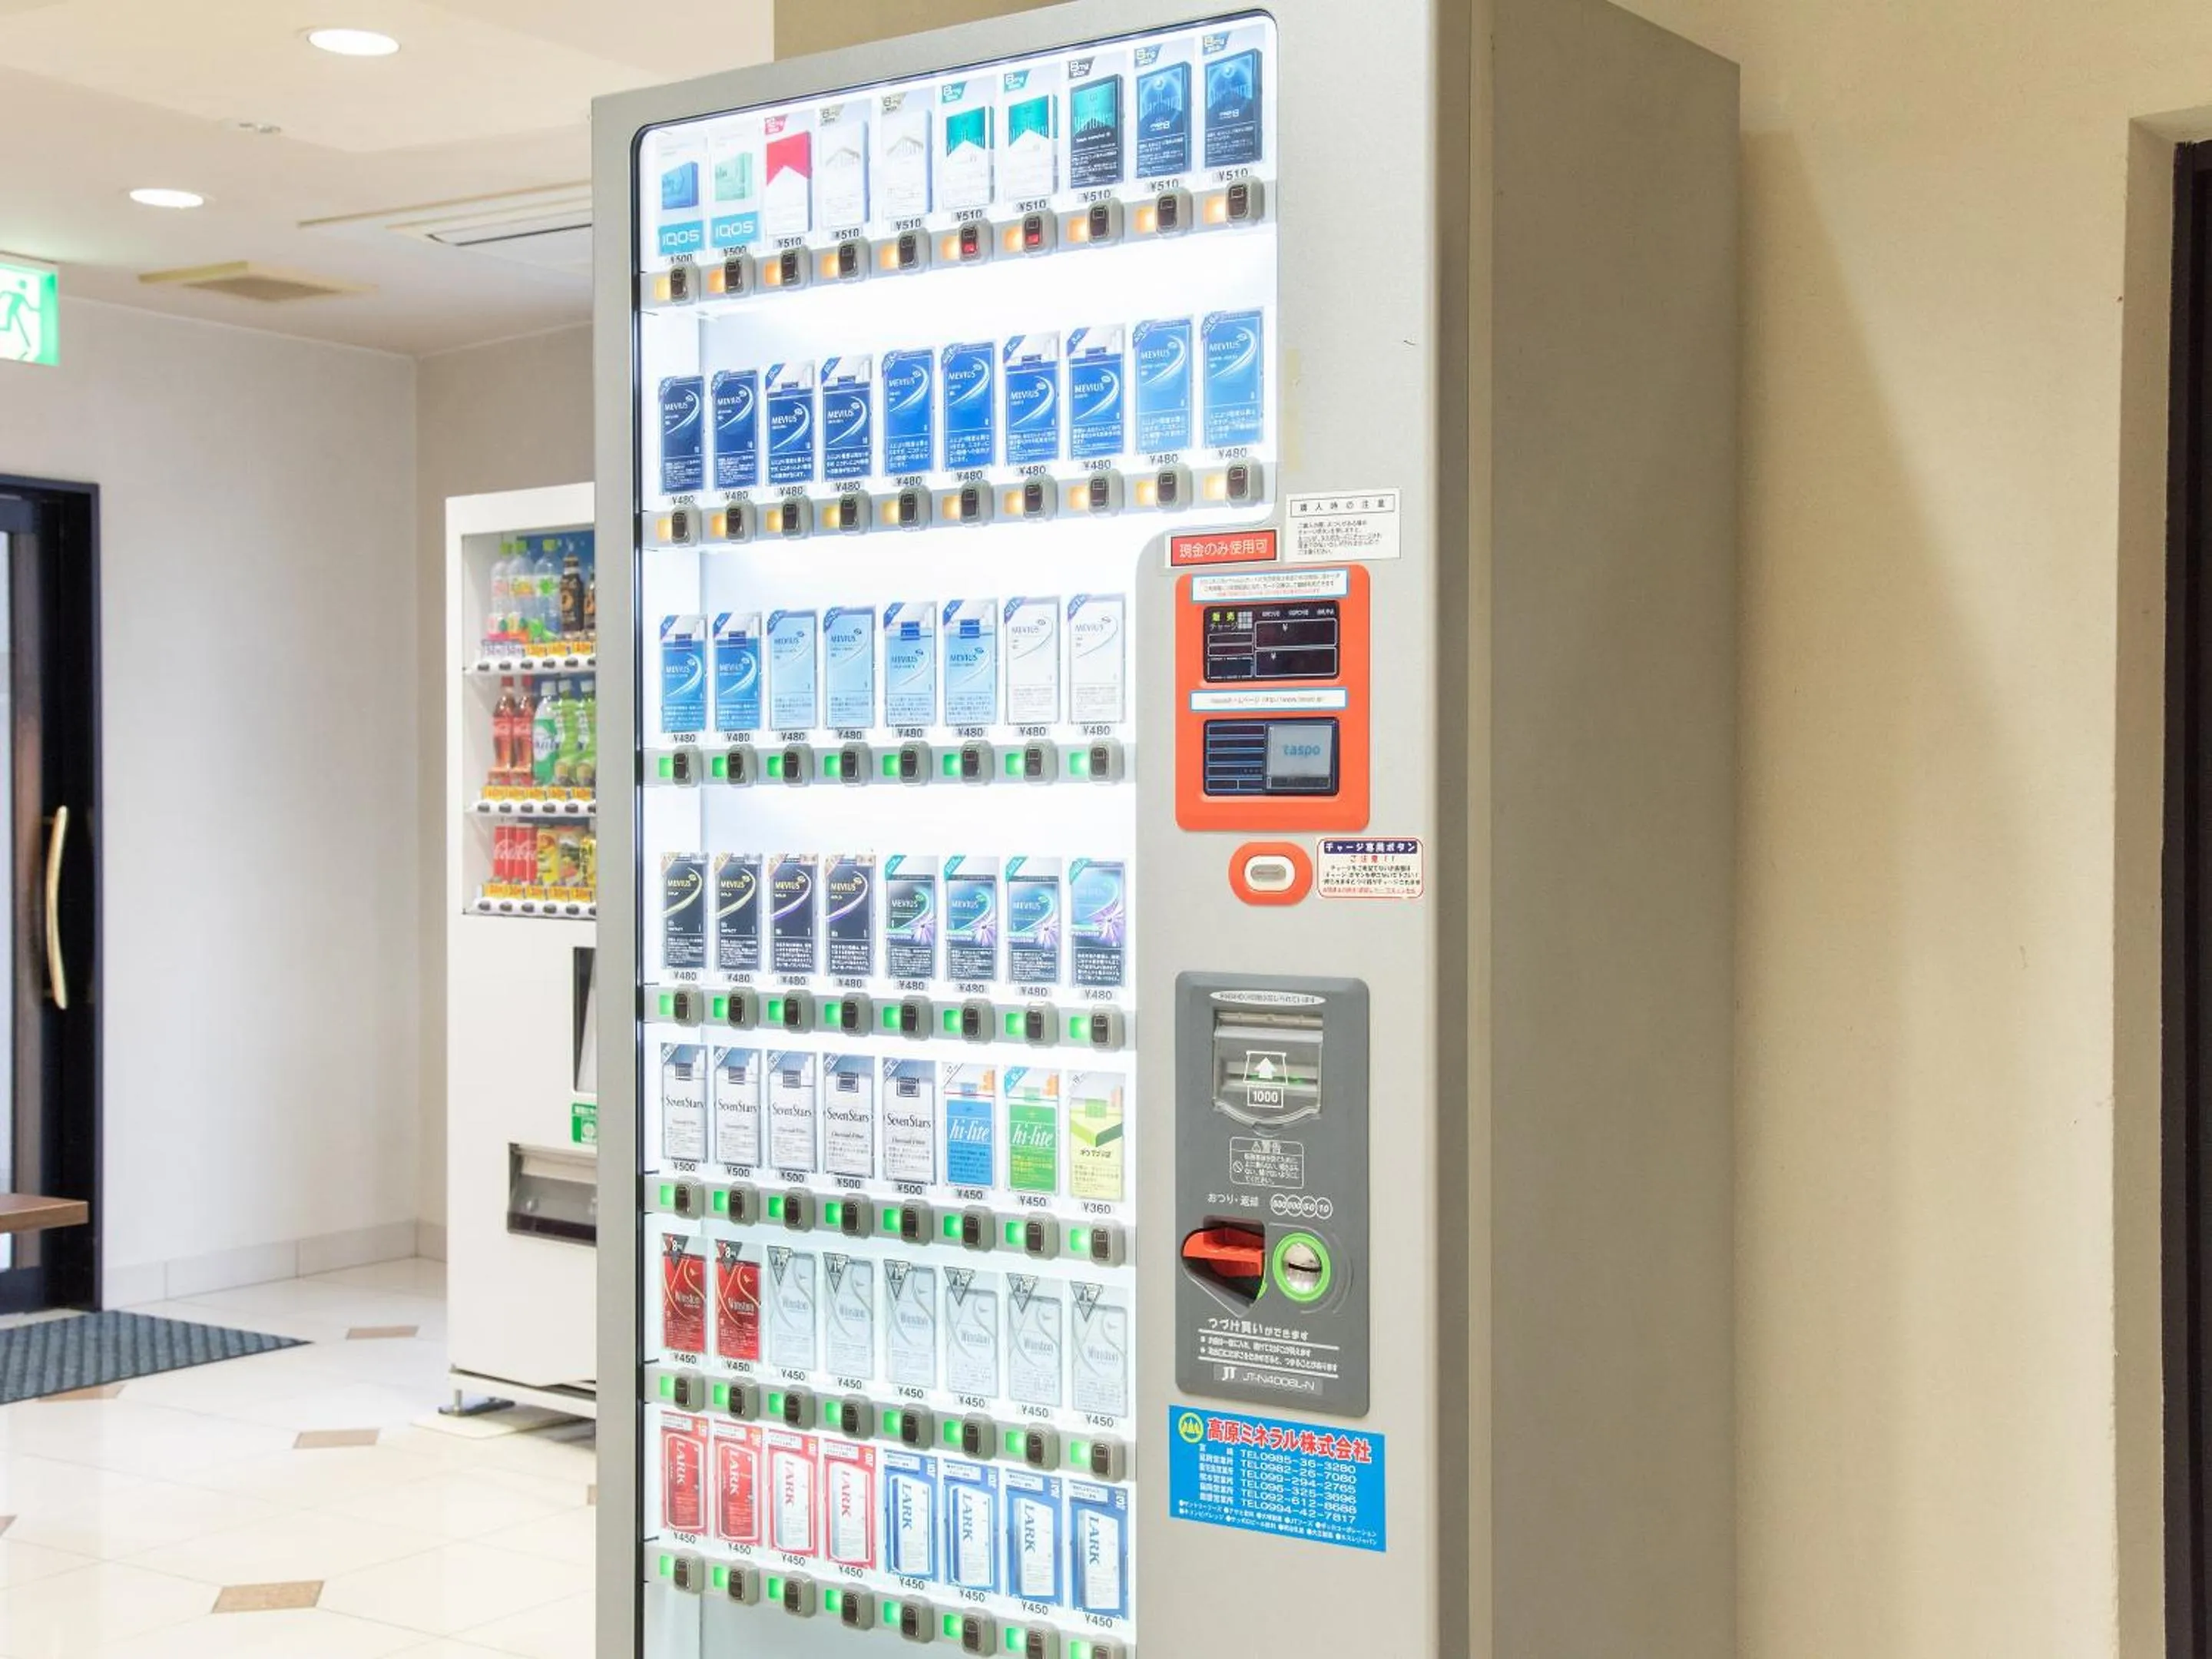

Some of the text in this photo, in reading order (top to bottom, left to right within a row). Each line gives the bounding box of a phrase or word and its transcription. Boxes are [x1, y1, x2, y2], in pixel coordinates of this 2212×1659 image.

[663, 229, 700, 246] IQOS
[716, 220, 754, 237] IQOS
[1179, 540, 1267, 558] 現金のみ使用可
[1283, 744, 1320, 757] taspo
[1253, 1091, 1278, 1103] 1000
[949, 1120, 989, 1141] hi-lite
[1012, 1124, 1051, 1146] hi-lite
[1222, 1366, 1237, 1381] JT
[1207, 1417, 1372, 1463] 高原ミネラル株式会社
[902, 1484, 912, 1530] LARK
[962, 1494, 972, 1540] LARK
[1025, 1505, 1035, 1553] LARK
[1088, 1516, 1099, 1565] LARK
